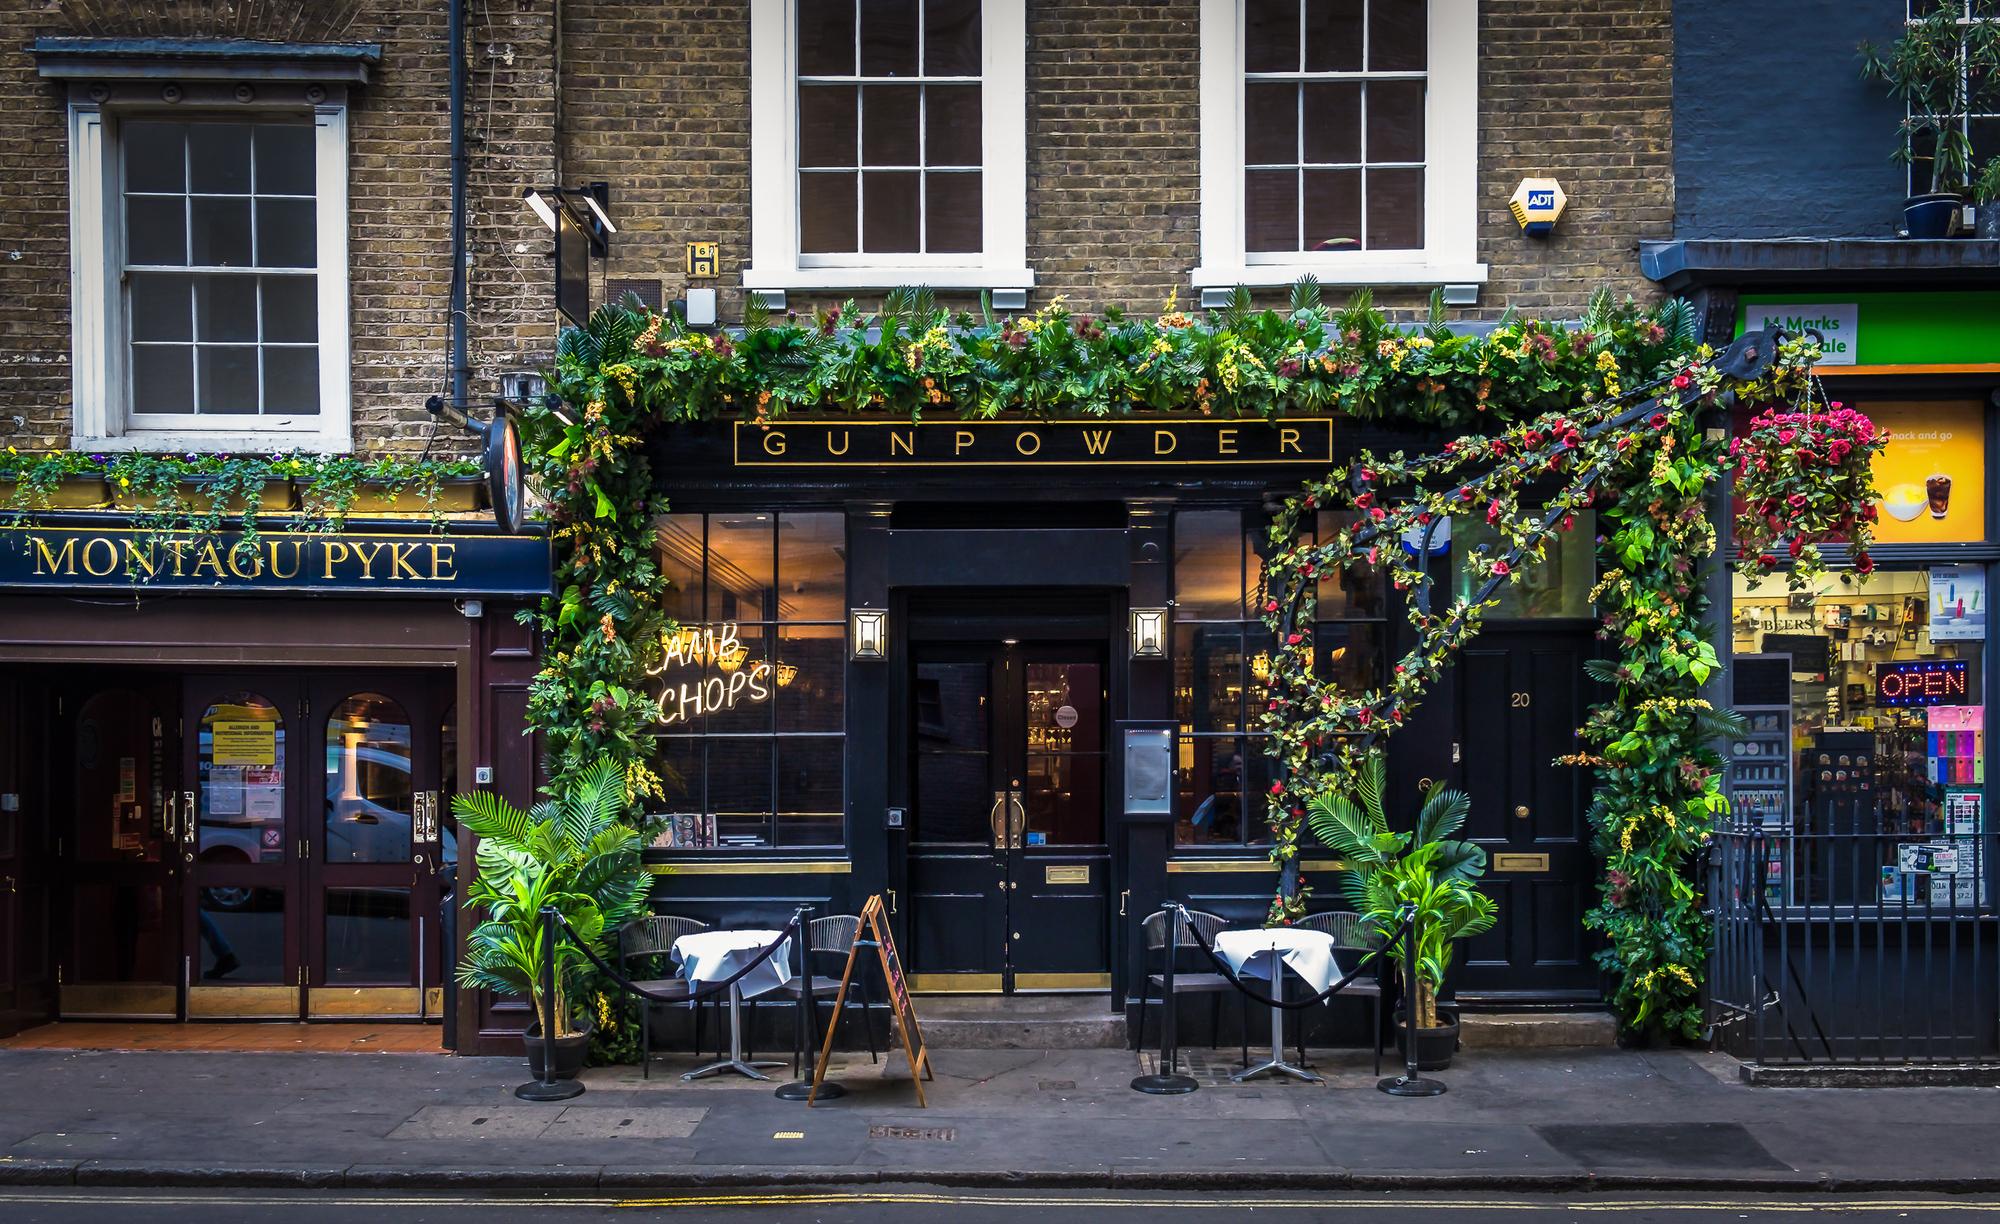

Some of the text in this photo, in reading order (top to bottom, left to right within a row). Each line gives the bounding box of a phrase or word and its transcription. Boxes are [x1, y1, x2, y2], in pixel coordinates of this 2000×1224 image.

[1528, 194, 1554, 206] ADT
[699, 264, 705, 272] 6
[1786, 315, 1840, 331] Marks
[763, 428, 1303, 455] GUNPOWDER
[1918, 430, 1937, 440] and
[1939, 432, 1953, 442] go
[31, 536, 458, 581] MONTAGU PYKE
[1763, 619, 1814, 631] BEERS
[1881, 671, 1965, 697] OPEN
[658, 664, 771, 724] CHOPS
[1511, 692, 1530, 707] 20
